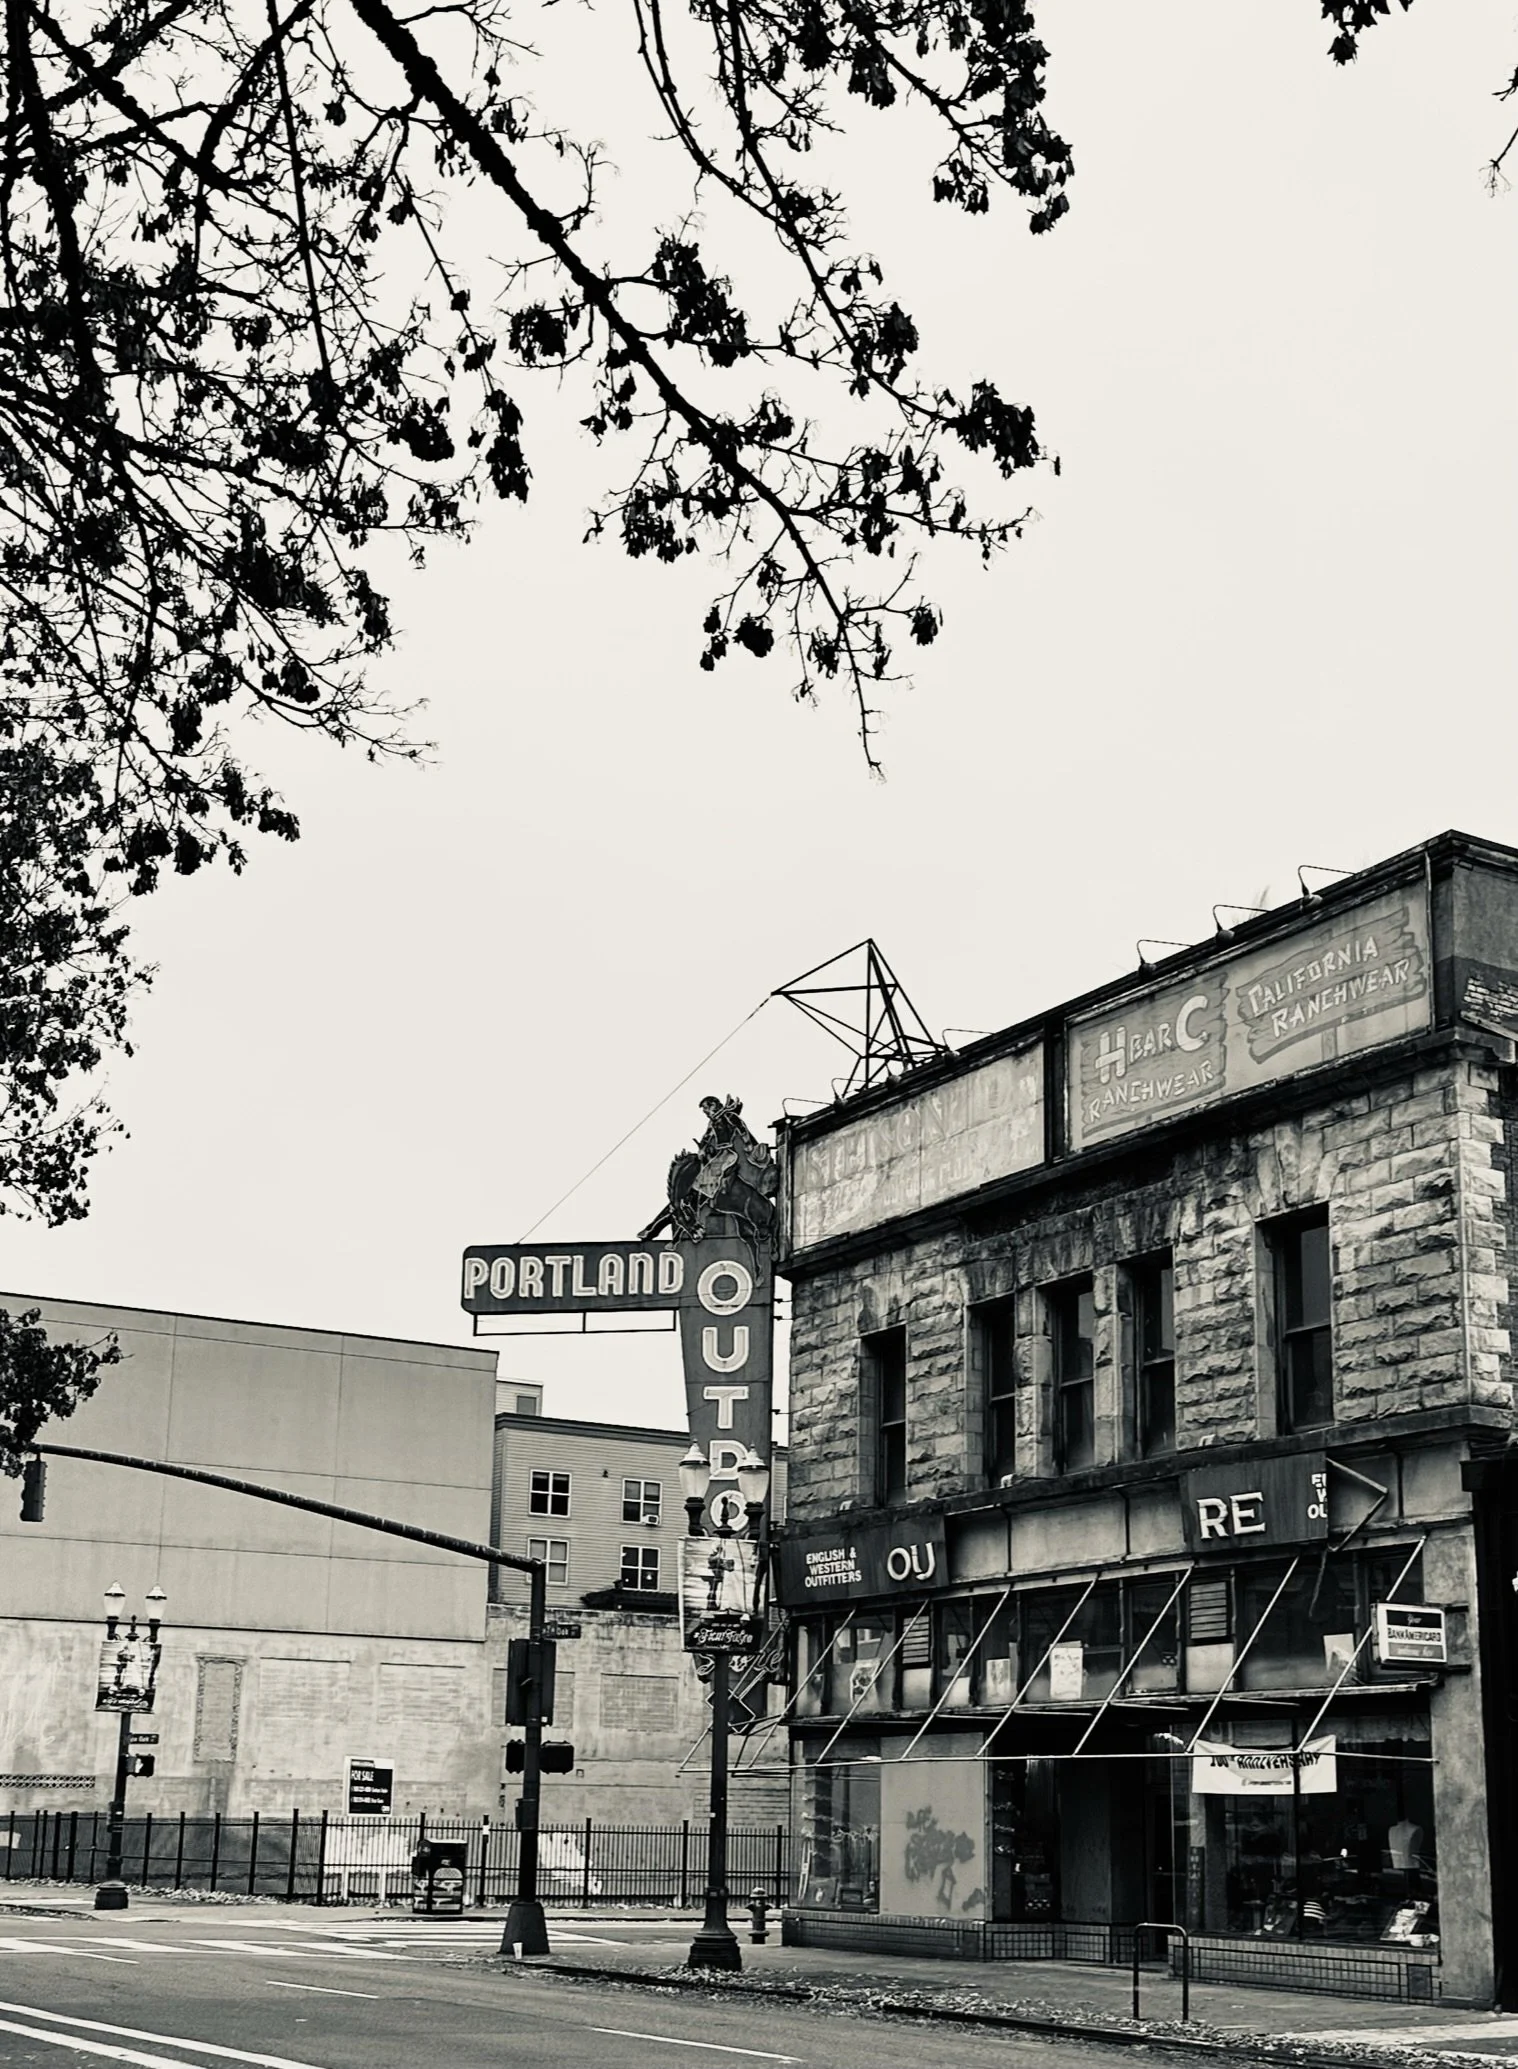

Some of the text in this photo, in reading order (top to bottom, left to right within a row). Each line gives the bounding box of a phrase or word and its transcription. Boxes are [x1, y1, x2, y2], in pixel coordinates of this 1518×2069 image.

[1247, 935, 1378, 1017] CALIFORNIA
[1271, 958, 1410, 1038] RANCHWEAR
[1088, 1059, 1214, 1122] RANCHWEAR
[463, 1252, 684, 1300] PORTLAND
[804, 1570, 862, 1588] OUTFITTERS
[805, 1546, 857, 1565] ENGLISH &
[809, 1559, 856, 1576] WESTERN
